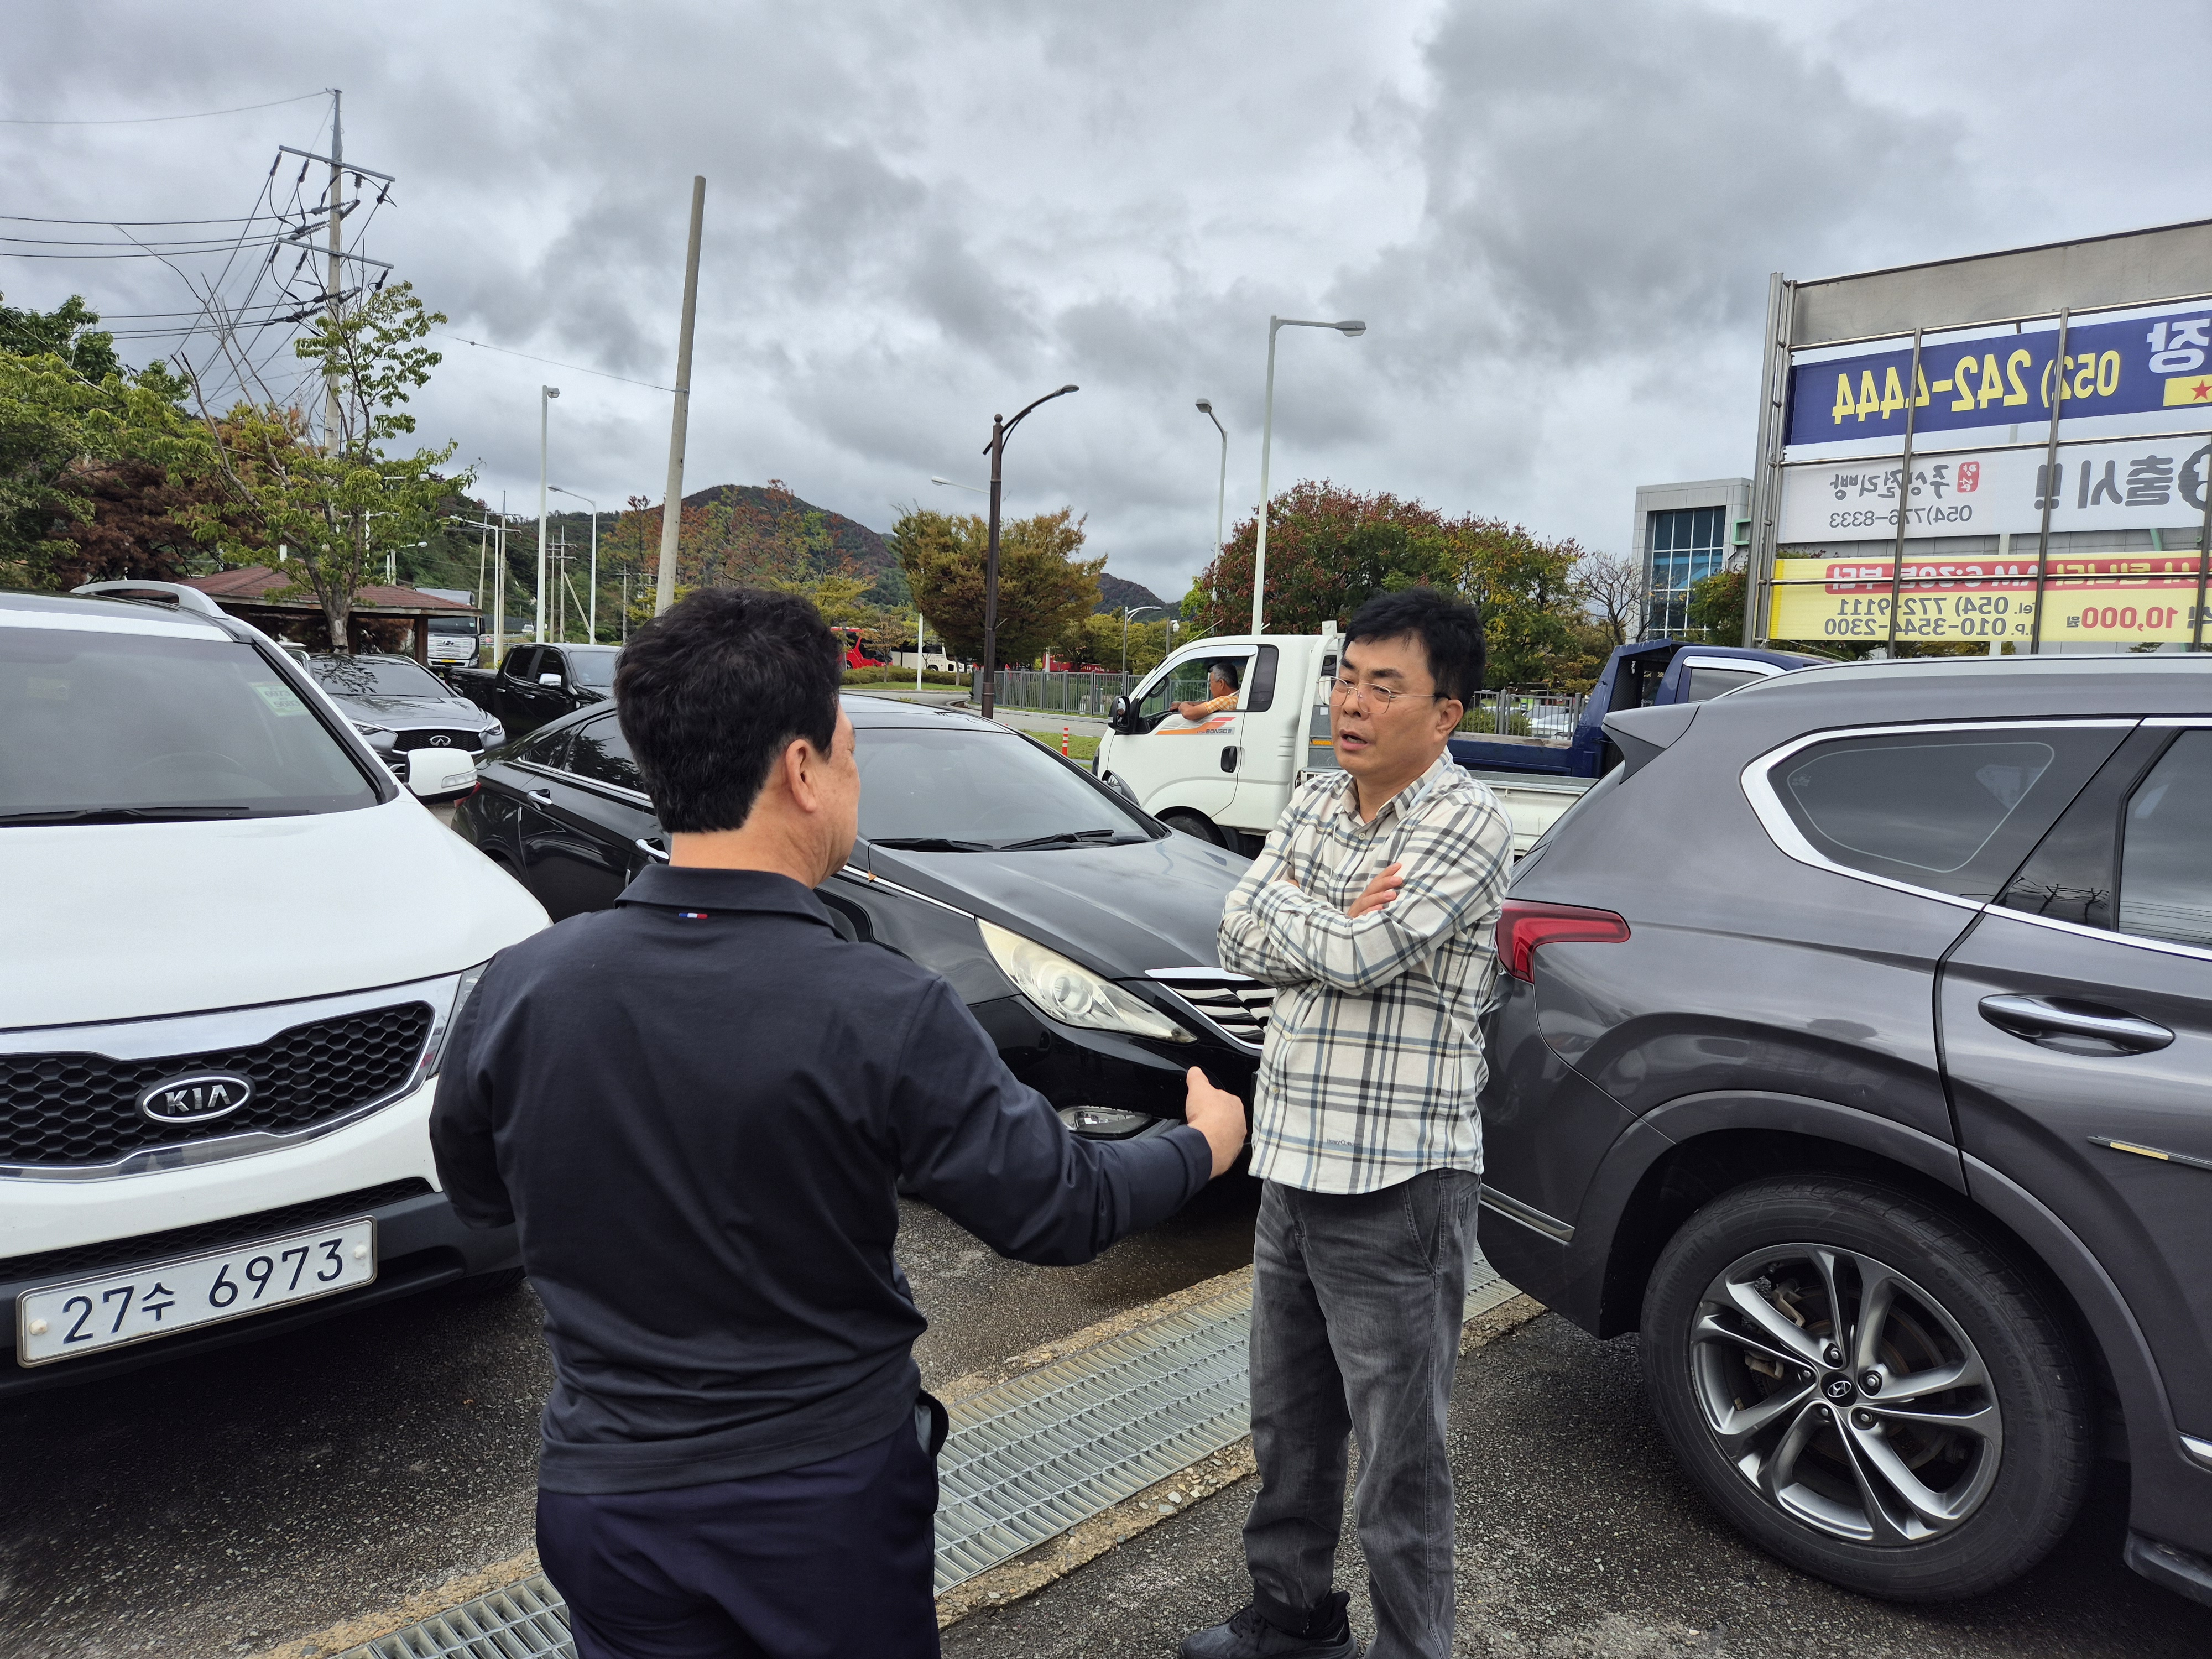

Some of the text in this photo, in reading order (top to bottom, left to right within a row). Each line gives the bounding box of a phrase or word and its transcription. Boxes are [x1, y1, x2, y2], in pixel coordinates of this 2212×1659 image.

[165, 1084, 232, 1115] KIA
[62, 1238, 343, 1345] 27수 6973
